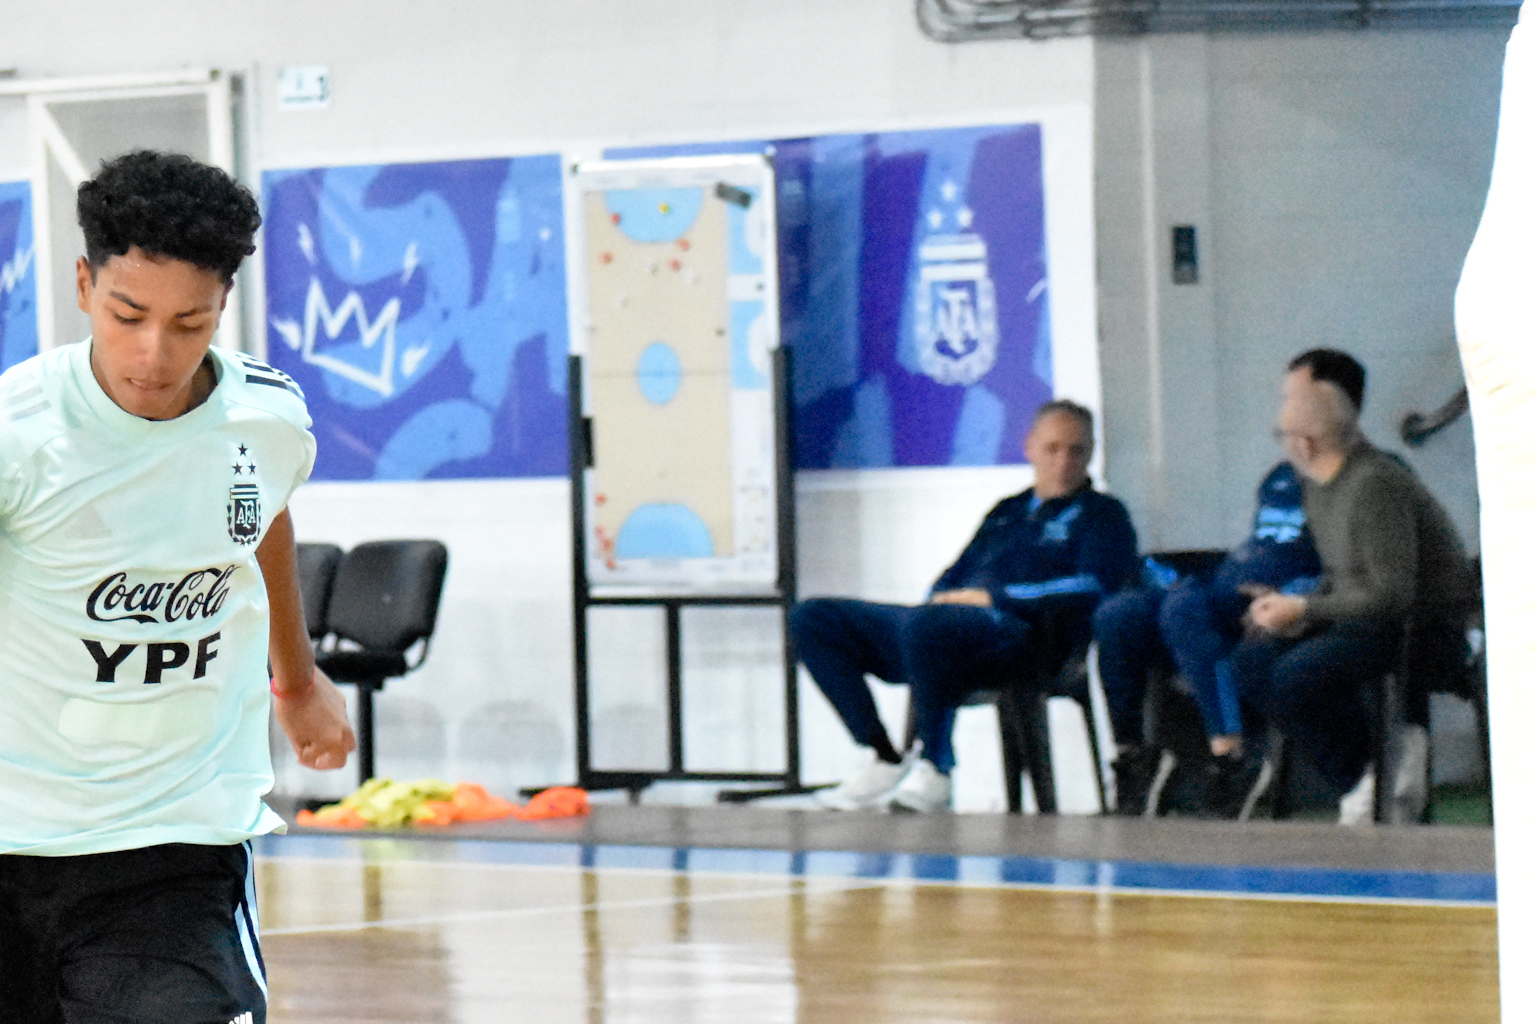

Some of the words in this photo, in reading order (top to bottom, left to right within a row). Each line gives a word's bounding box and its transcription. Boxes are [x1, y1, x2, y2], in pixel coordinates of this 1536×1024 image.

[235, 500, 257, 529] AFA
[86, 564, 241, 625] Coca-Cola
[80, 631, 222, 684] YPF
